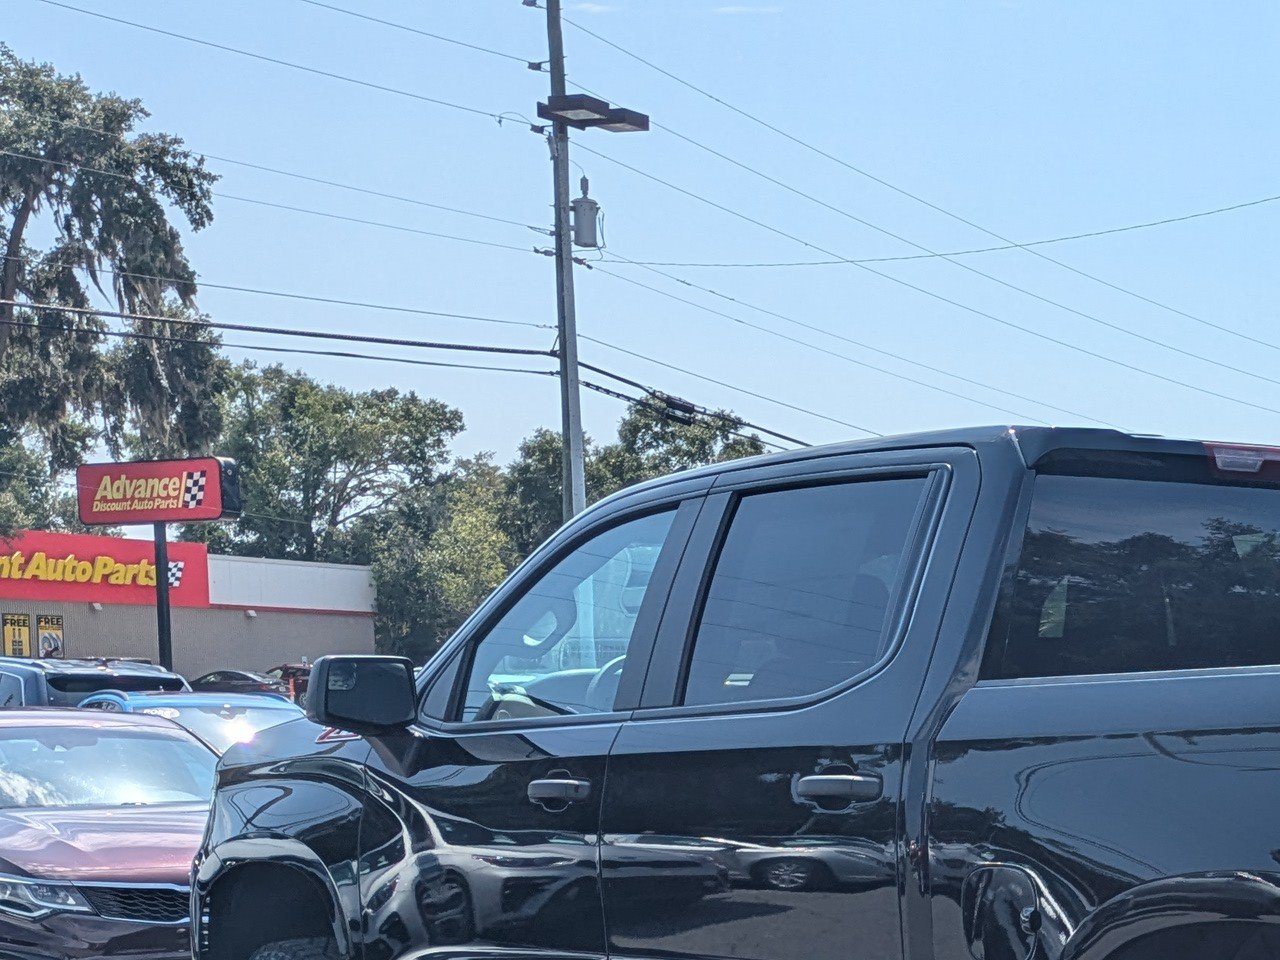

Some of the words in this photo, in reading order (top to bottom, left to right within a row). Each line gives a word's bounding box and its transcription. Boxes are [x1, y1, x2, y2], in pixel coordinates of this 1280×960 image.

[94, 474, 181, 500] Advance
[92, 500, 131, 512] Discount
[131, 498, 153, 510] Auto
[153, 498, 177, 509] Parts
[23, 552, 92, 583] Auto
[2, 619, 28, 627] FREE
[38, 617, 62, 626] FREE
